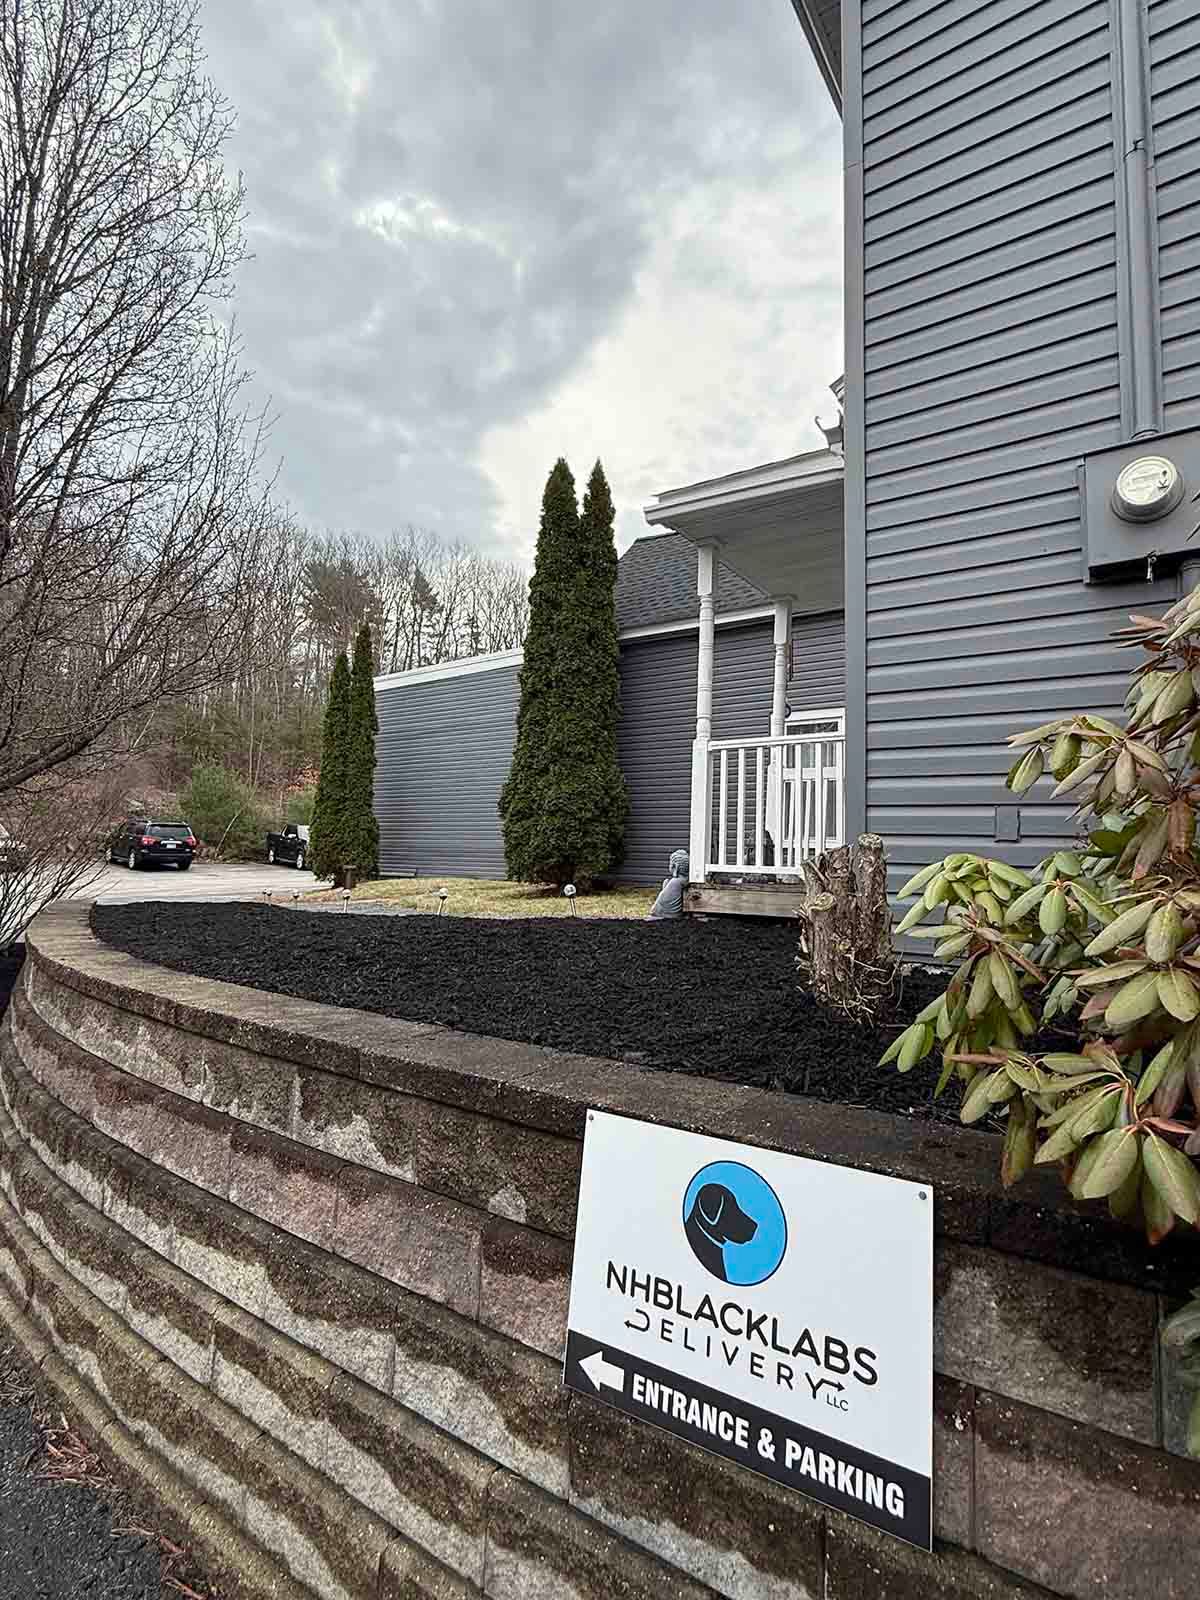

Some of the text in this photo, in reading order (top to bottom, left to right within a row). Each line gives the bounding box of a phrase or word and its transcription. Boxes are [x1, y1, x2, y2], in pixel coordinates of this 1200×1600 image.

[606, 1261, 879, 1386] NHBLACKLABS
[624, 1308, 845, 1399] DELIVERY
[632, 1373, 905, 1519] ENTRANCE & PARKING
[826, 1391, 849, 1412] LLC
